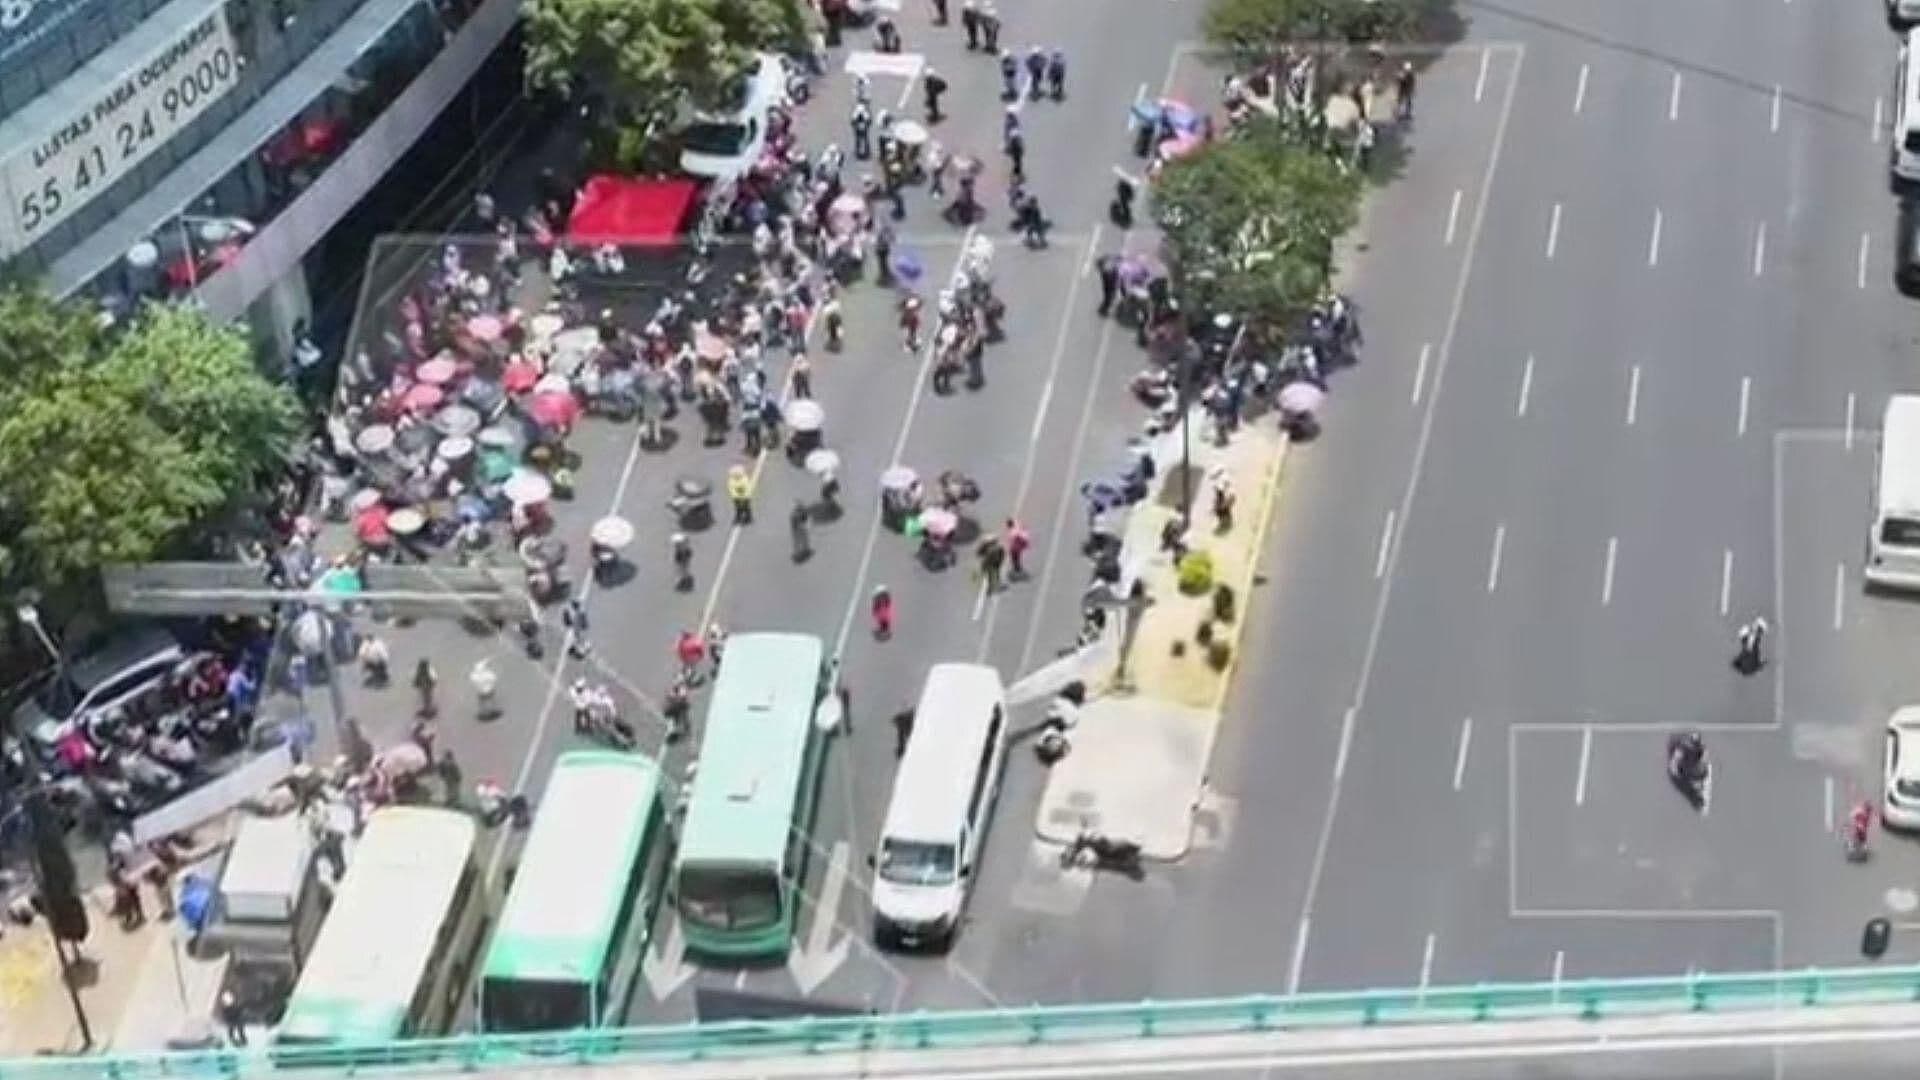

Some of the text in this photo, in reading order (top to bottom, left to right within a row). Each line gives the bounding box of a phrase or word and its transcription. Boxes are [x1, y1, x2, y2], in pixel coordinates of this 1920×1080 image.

[22, 47, 230, 231] 55 41 24 9000
[94, 80, 137, 121] PARA
